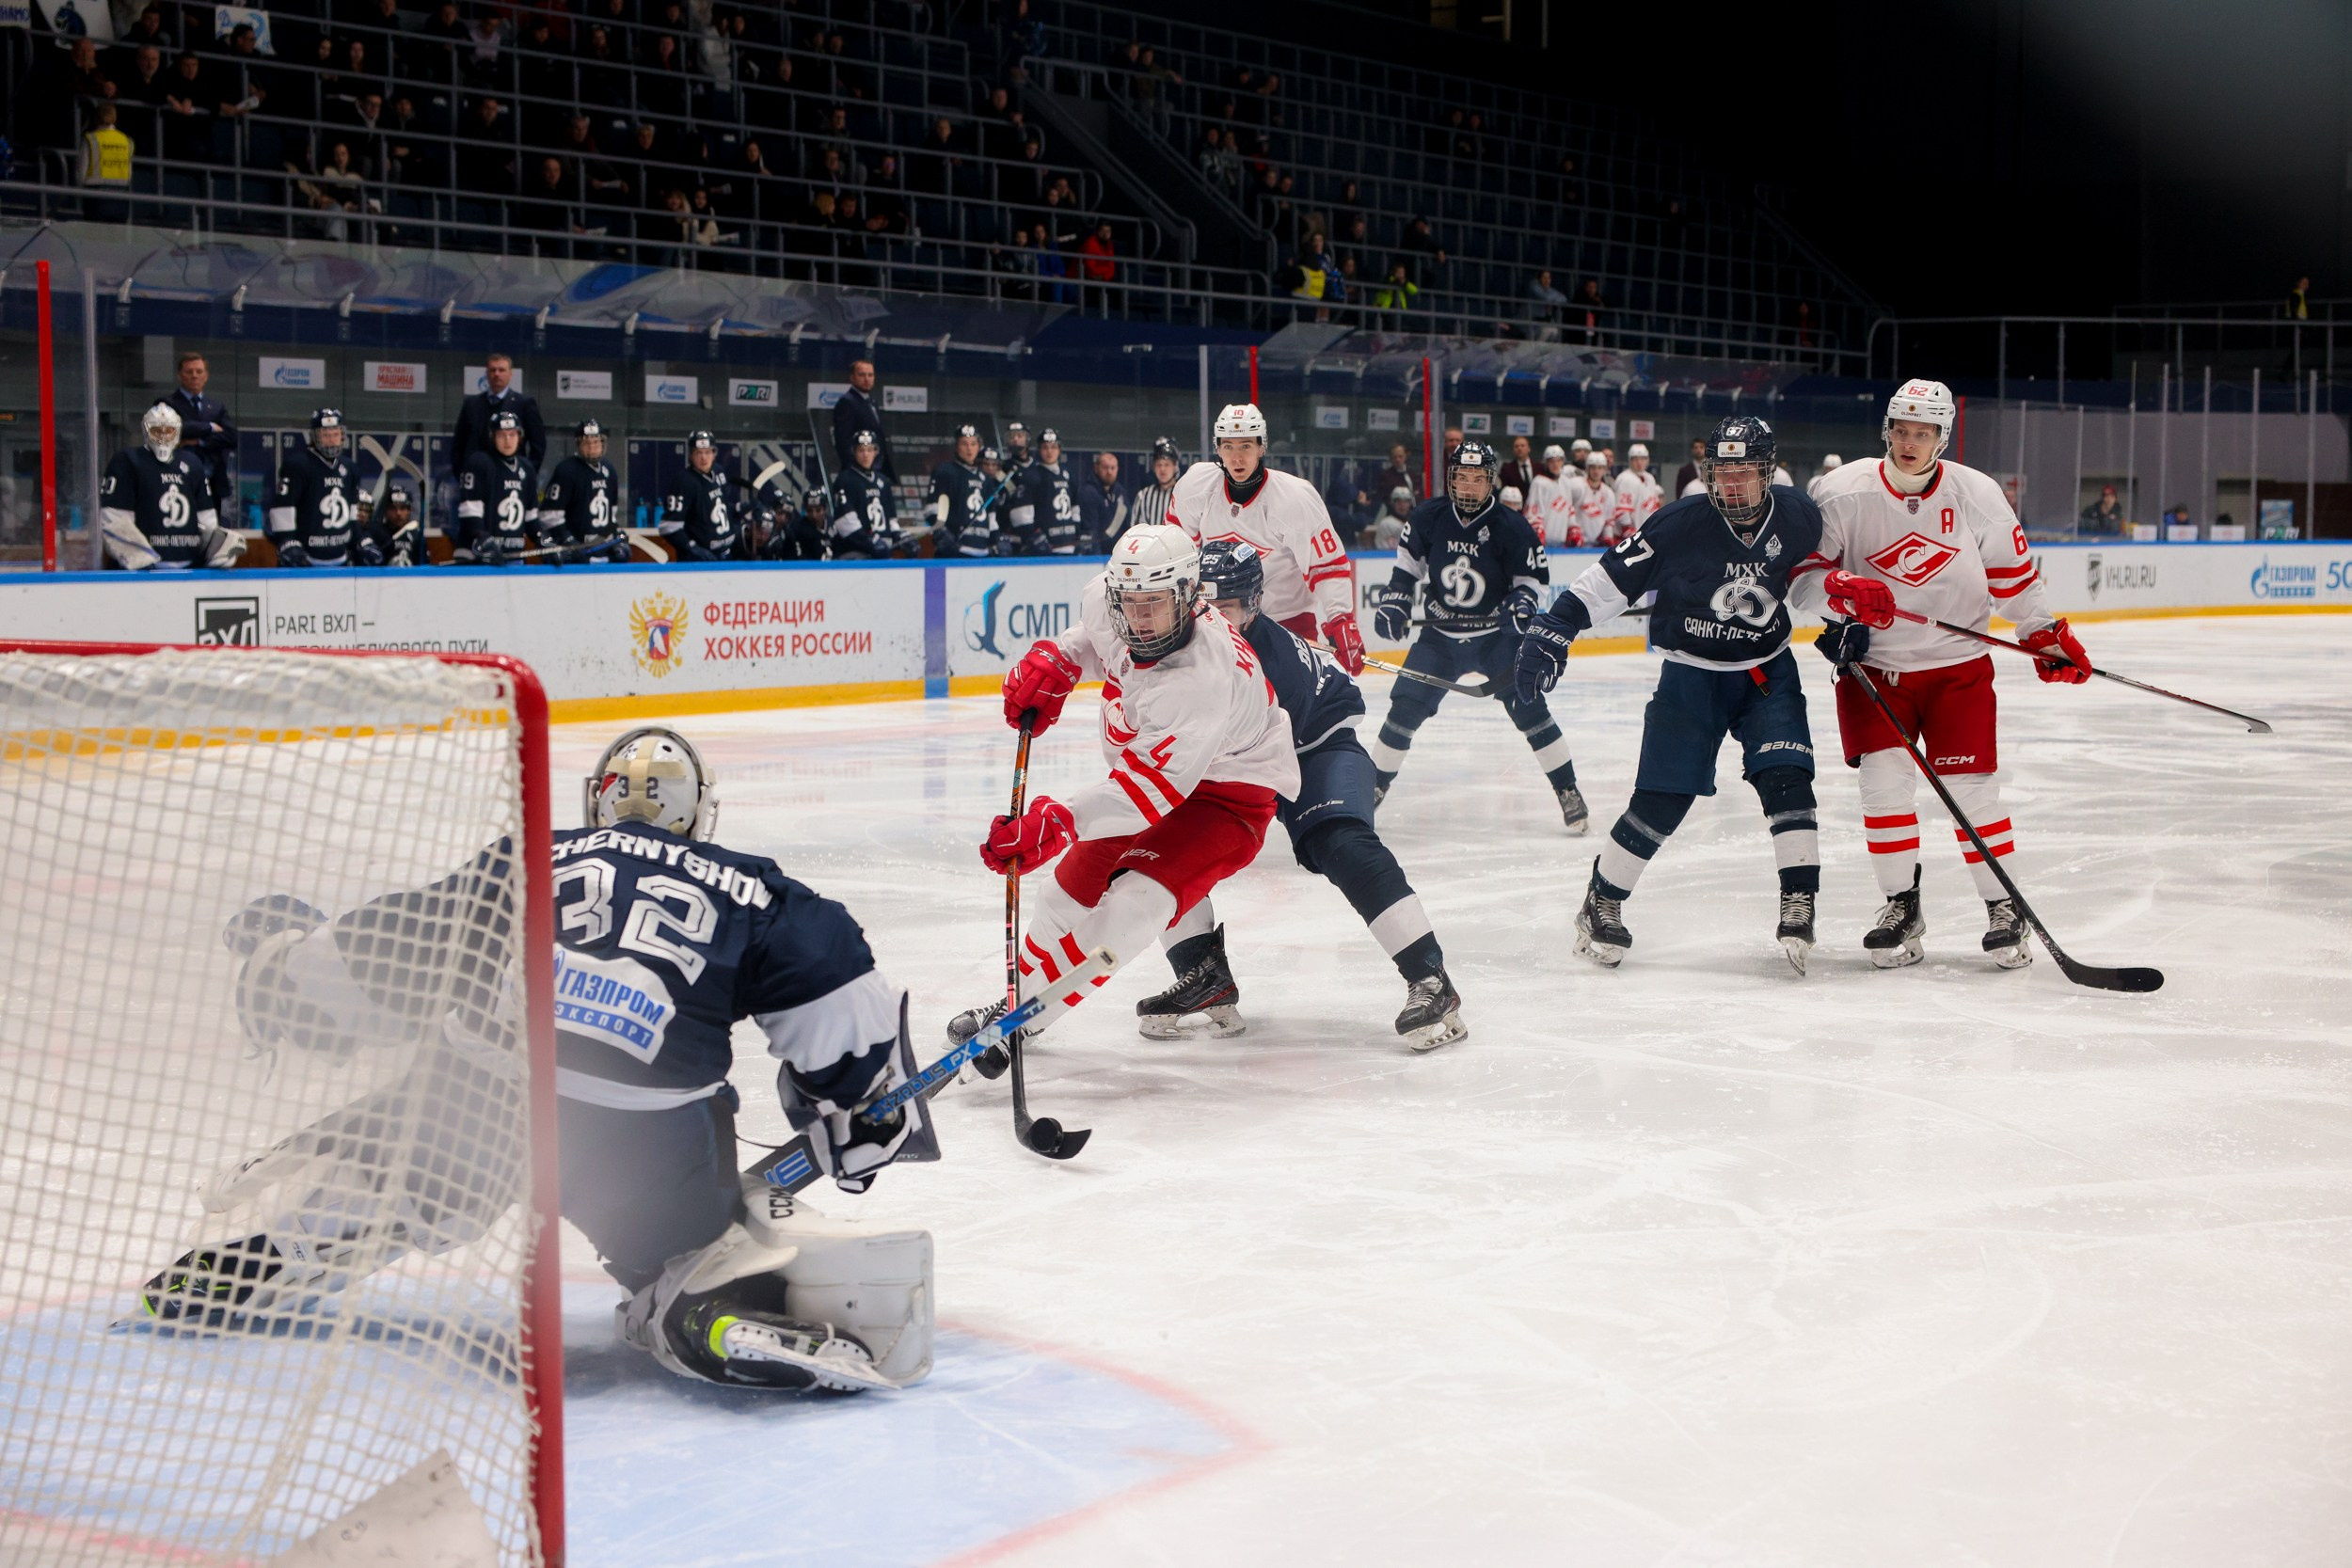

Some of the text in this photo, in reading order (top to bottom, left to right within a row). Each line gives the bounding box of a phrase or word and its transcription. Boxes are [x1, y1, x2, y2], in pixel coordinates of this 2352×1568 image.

[1908, 386, 1929, 397] 62
[1128, 538, 1139, 555] 4
[1311, 529, 1338, 559] 18
[1447, 540, 1480, 559] МХК
[1614, 531, 1655, 568] 67
[2011, 524, 2029, 557] 6
[1201, 553, 1222, 565] 25
[1526, 545, 1549, 571] 42
[1724, 562, 1770, 578] МХК
[2106, 566, 2157, 589] VHLRU.RU
[2270, 566, 2316, 582] ГАЗПРОМ
[275, 615, 316, 636] PARI
[323, 614, 356, 633] ВХЛ
[703, 599, 824, 630] ФЕДЕРАЦИЯ
[1009, 602, 1070, 640] СМП
[704, 631, 872, 661] ХОККЕЯ РОССИИ
[1526, 625, 1572, 648] BAUER
[1149, 734, 1178, 771] 4
[1756, 740, 1814, 756] BAUER
[1934, 754, 1976, 767] CCM
[551, 857, 719, 987] 32
[559, 968, 665, 1026] ГАЗПРОМ
[554, 1004, 654, 1049] ЭКСПОРТ
[949, 1043, 973, 1066] PX
[769, 1184, 794, 1220] CCM
